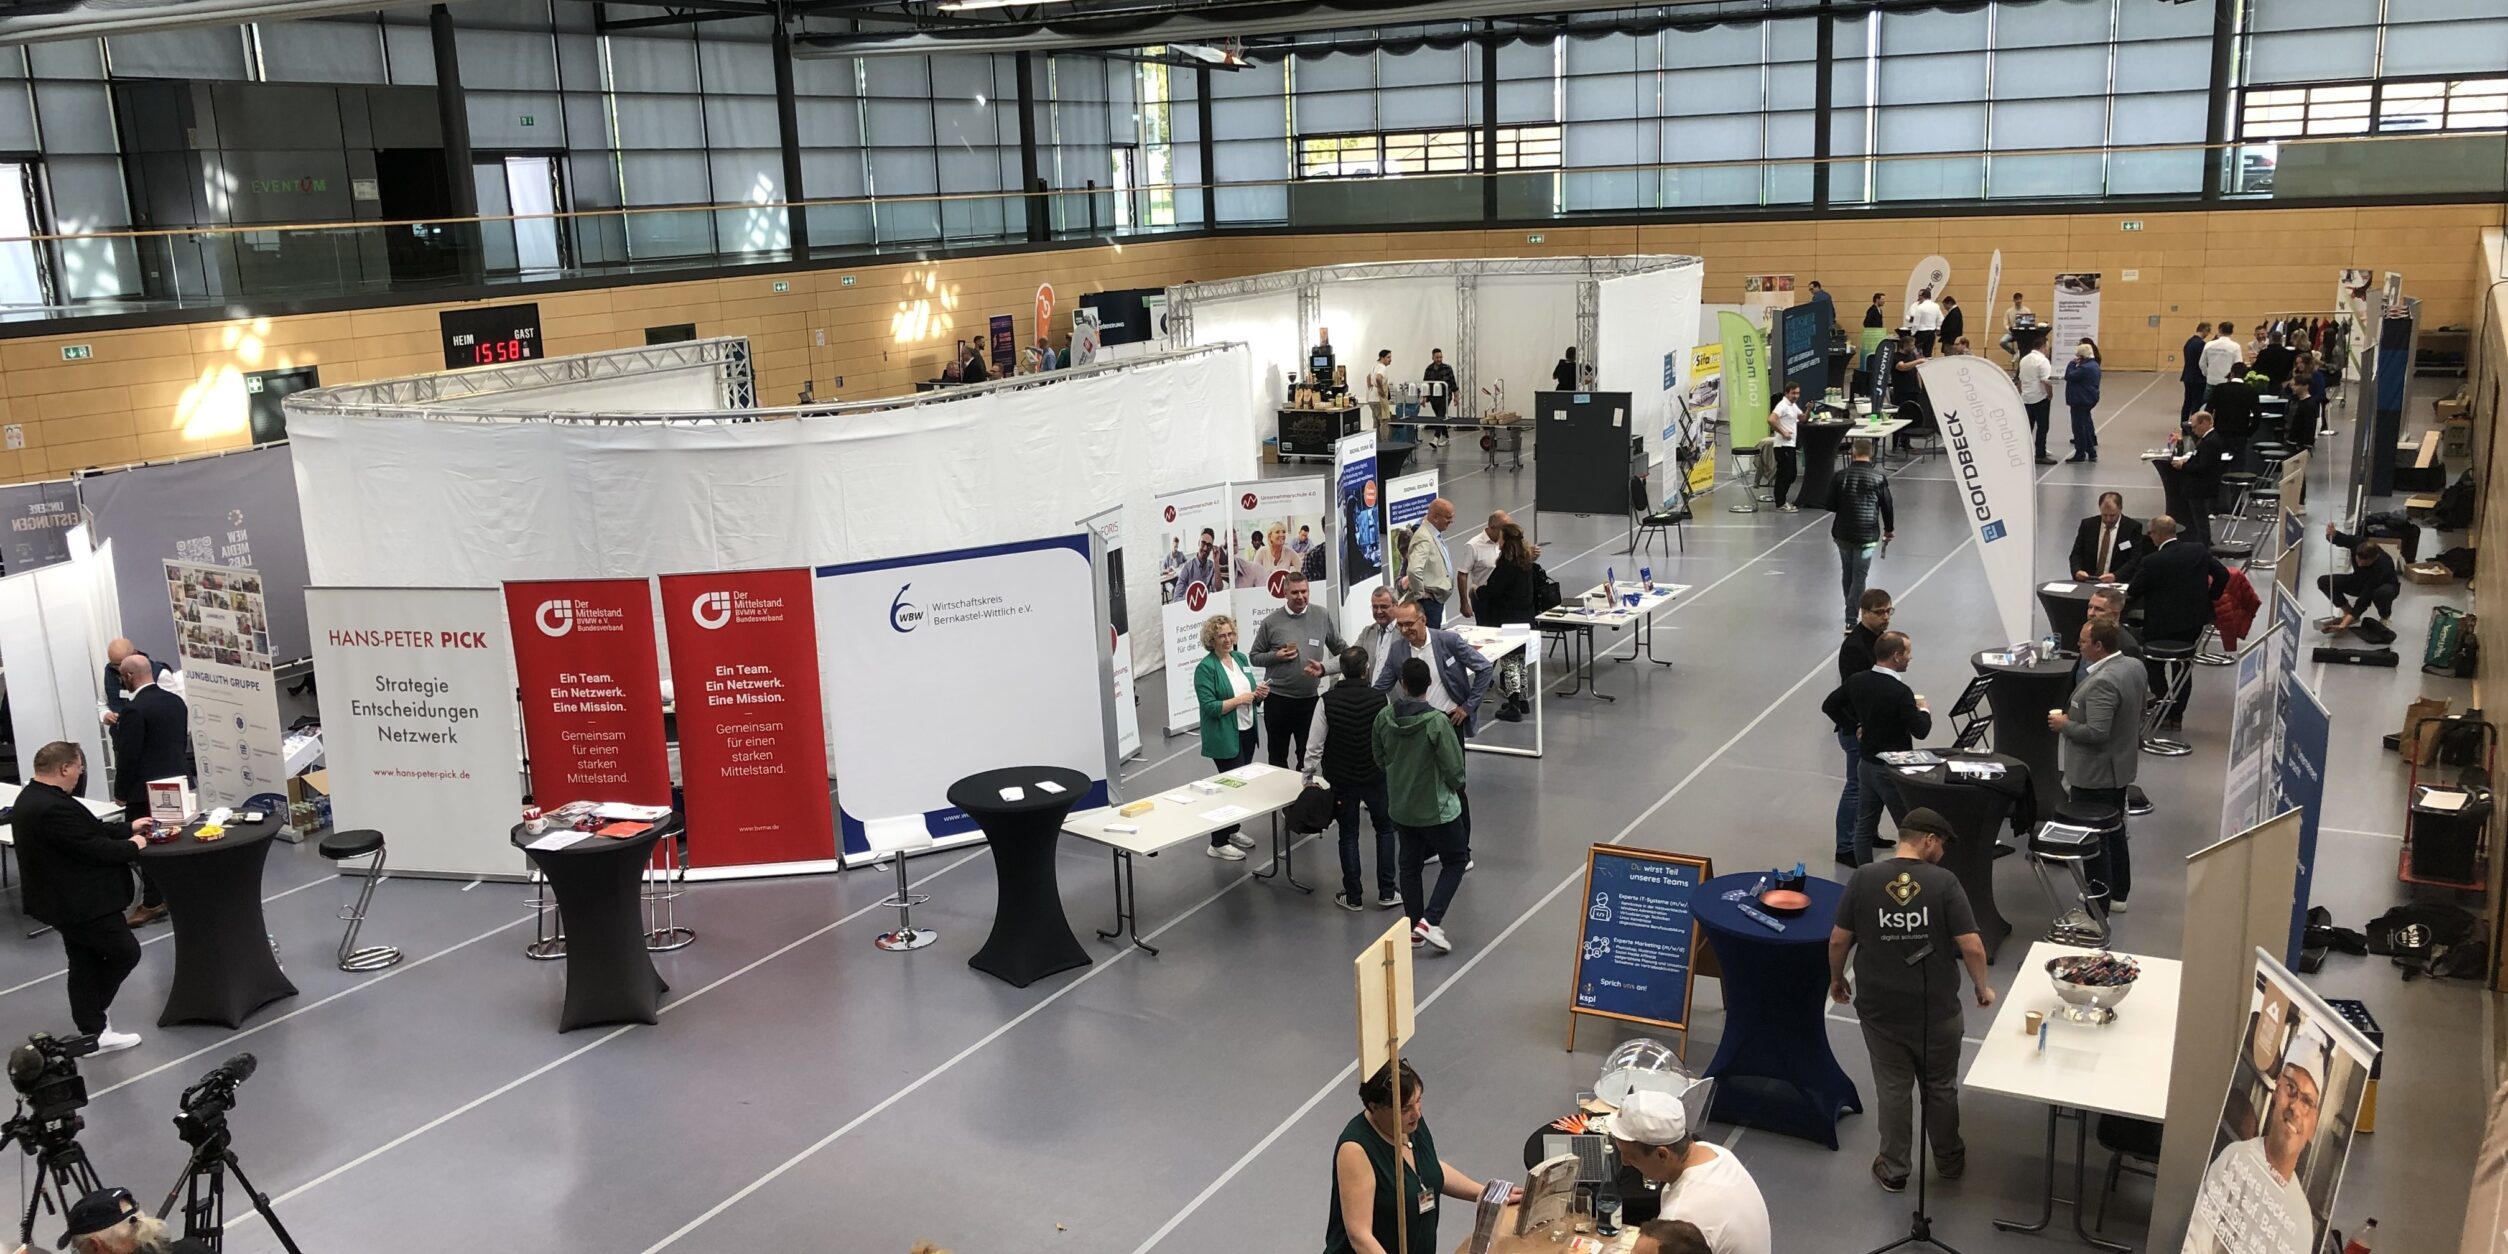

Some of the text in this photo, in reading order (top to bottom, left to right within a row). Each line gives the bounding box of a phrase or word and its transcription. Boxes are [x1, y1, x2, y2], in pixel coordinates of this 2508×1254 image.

[250, 178, 327, 193] EVENTUM
[453, 334, 474, 346] HEIM
[514, 328, 534, 340] GAST
[733, 591, 748, 600] Der
[574, 600, 589, 608] Der
[932, 596, 1003, 612] Wirtschaftskreis
[736, 614, 784, 623] Bundesverband
[900, 611, 924, 622] WBW
[934, 607, 1016, 625] Bernkastel-Wittlich
[577, 624, 624, 632] Bundesverband
[328, 629, 488, 649] HANS-PETER PICK
[716, 665, 772, 676] Ein Team.
[185, 670, 229, 686] JUNGBLUTH
[229, 676, 261, 692] GRUPPE
[560, 673, 614, 683] Ein Team.
[375, 675, 449, 697] Strategie
[706, 678, 785, 691] Ein Netzwerk.
[550, 687, 626, 698] Ein Netzwerk.
[708, 692, 785, 706] Eine Mission.
[351, 700, 479, 723] Entscheidungen
[553, 701, 627, 712] Eine Mission.
[716, 722, 783, 734] Gemeinsam
[378, 726, 458, 744] Netzwerk
[561, 730, 626, 741] Gemeinsam
[727, 737, 775, 748] für einen
[572, 744, 619, 755] für einen
[732, 751, 773, 762] starken
[577, 759, 617, 769] starken
[721, 763, 786, 777] Mittelstand.
[373, 768, 470, 781] www.hans-peter-pick.de
[567, 772, 629, 783] Mittelstand.
[1644, 865, 1663, 874] wirst
[1665, 867, 1679, 876] Teil
[1629, 874, 1689, 887] unseres Teams
[1878, 906, 1928, 932] kspl
[1613, 937, 1633, 945] Experte
[1600, 978, 1622, 987] Sprich
[1636, 984, 1648, 992] an!
[1579, 993, 1596, 1004] kspl
[2262, 1185, 2297, 1235] backen
[2260, 1212, 2278, 1242] Bei
